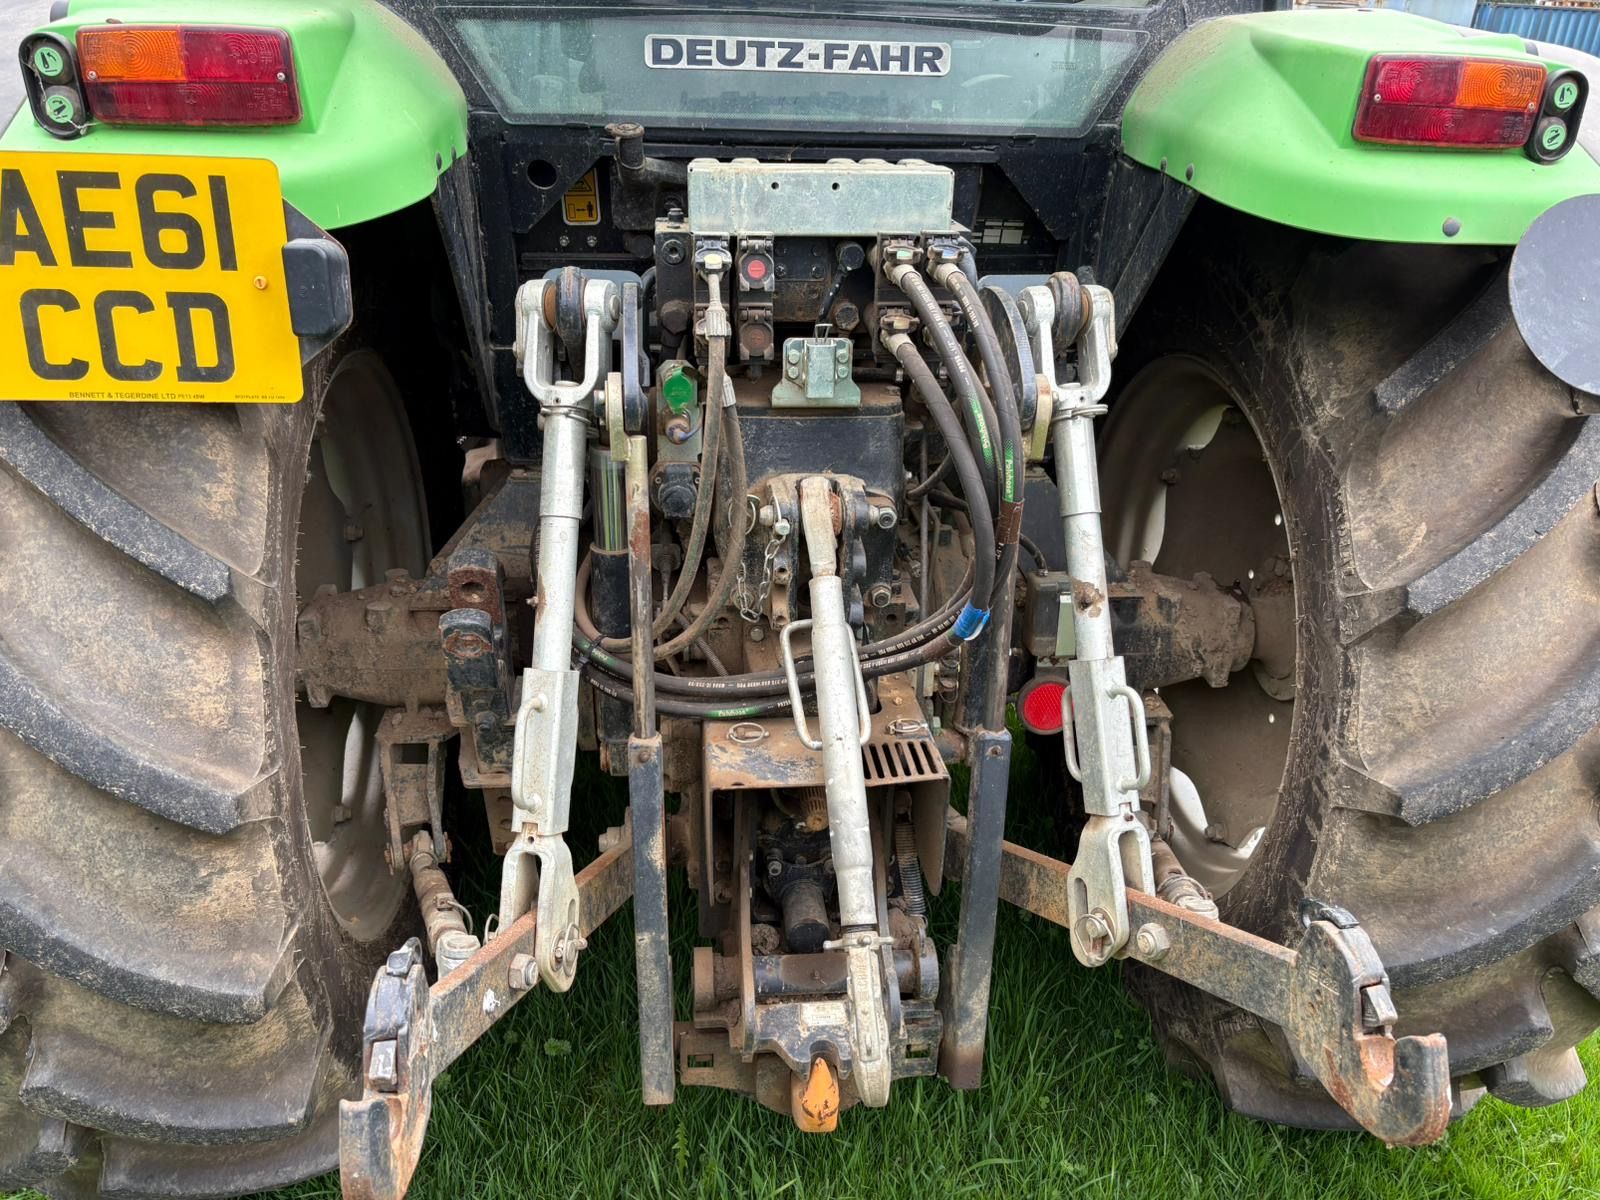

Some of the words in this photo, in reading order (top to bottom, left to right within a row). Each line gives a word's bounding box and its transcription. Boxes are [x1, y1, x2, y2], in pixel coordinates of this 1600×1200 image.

[651, 38, 945, 73] DEUTZ-FAHR
[0, 168, 239, 272] AE61
[19, 288, 236, 384] CCD
[69, 391, 105, 399] BENNETT
[161, 392, 176, 400] LTD
